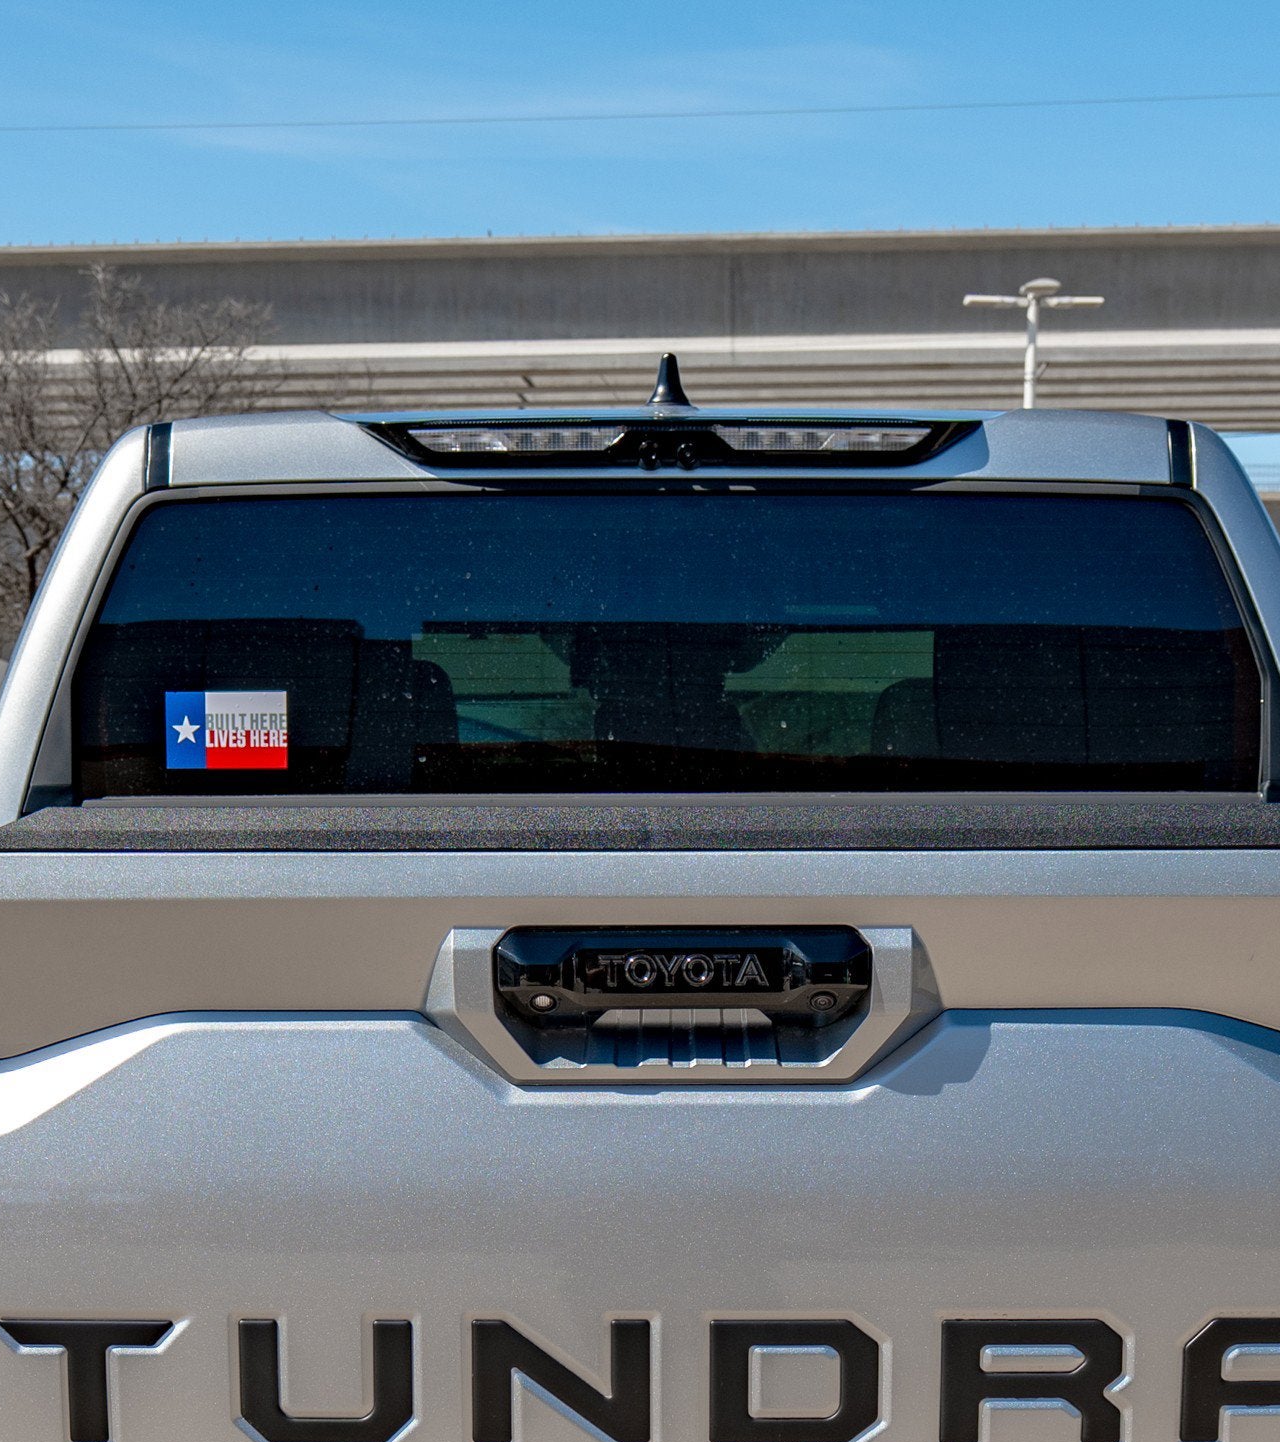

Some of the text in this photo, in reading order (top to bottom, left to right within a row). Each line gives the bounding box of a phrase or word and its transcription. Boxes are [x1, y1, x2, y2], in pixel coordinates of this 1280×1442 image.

[206, 713, 287, 730] BUILT HERE
[206, 729, 288, 747] LIVES HERE
[598, 953, 769, 987] TOYOTA
